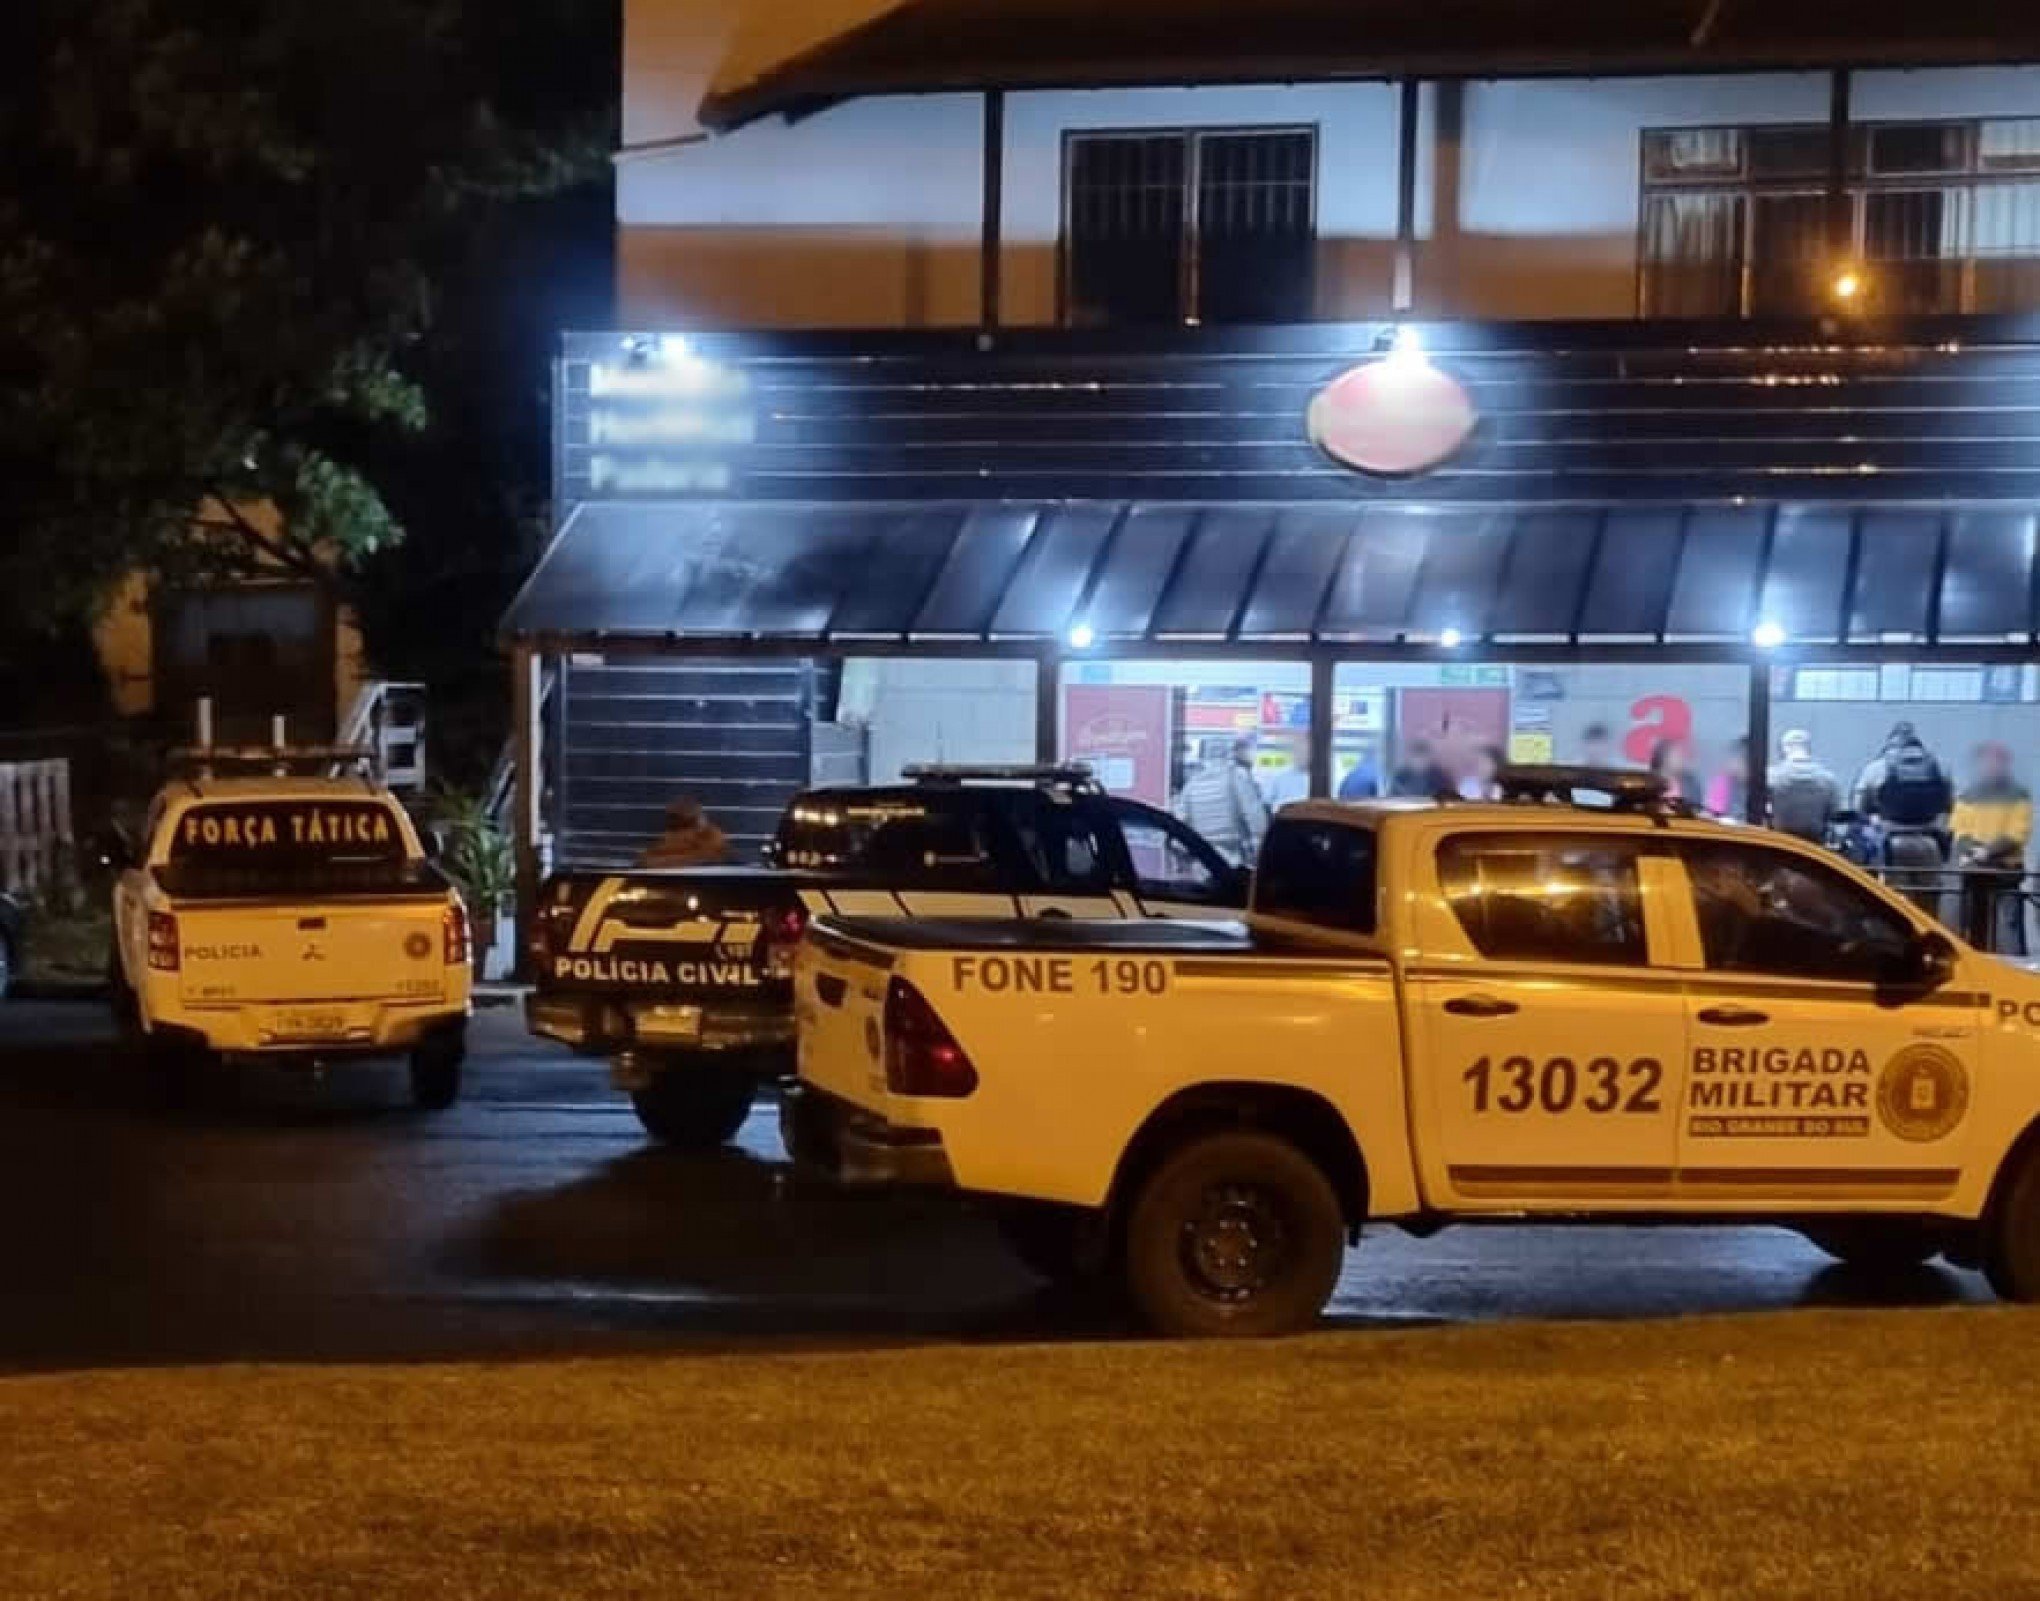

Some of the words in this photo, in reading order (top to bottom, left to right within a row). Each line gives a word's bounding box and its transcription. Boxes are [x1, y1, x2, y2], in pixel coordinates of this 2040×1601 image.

[184, 816, 277, 847] FORÇA
[291, 808, 389, 844] TÁTICA
[678, 963, 760, 985] CIVIL
[953, 957, 1073, 993] FONE
[1090, 959, 1166, 995] 190
[1692, 1047, 1871, 1074] BRIGADA
[1462, 1055, 1663, 1114] 13032
[1689, 1081, 1868, 1107] MILITAR
